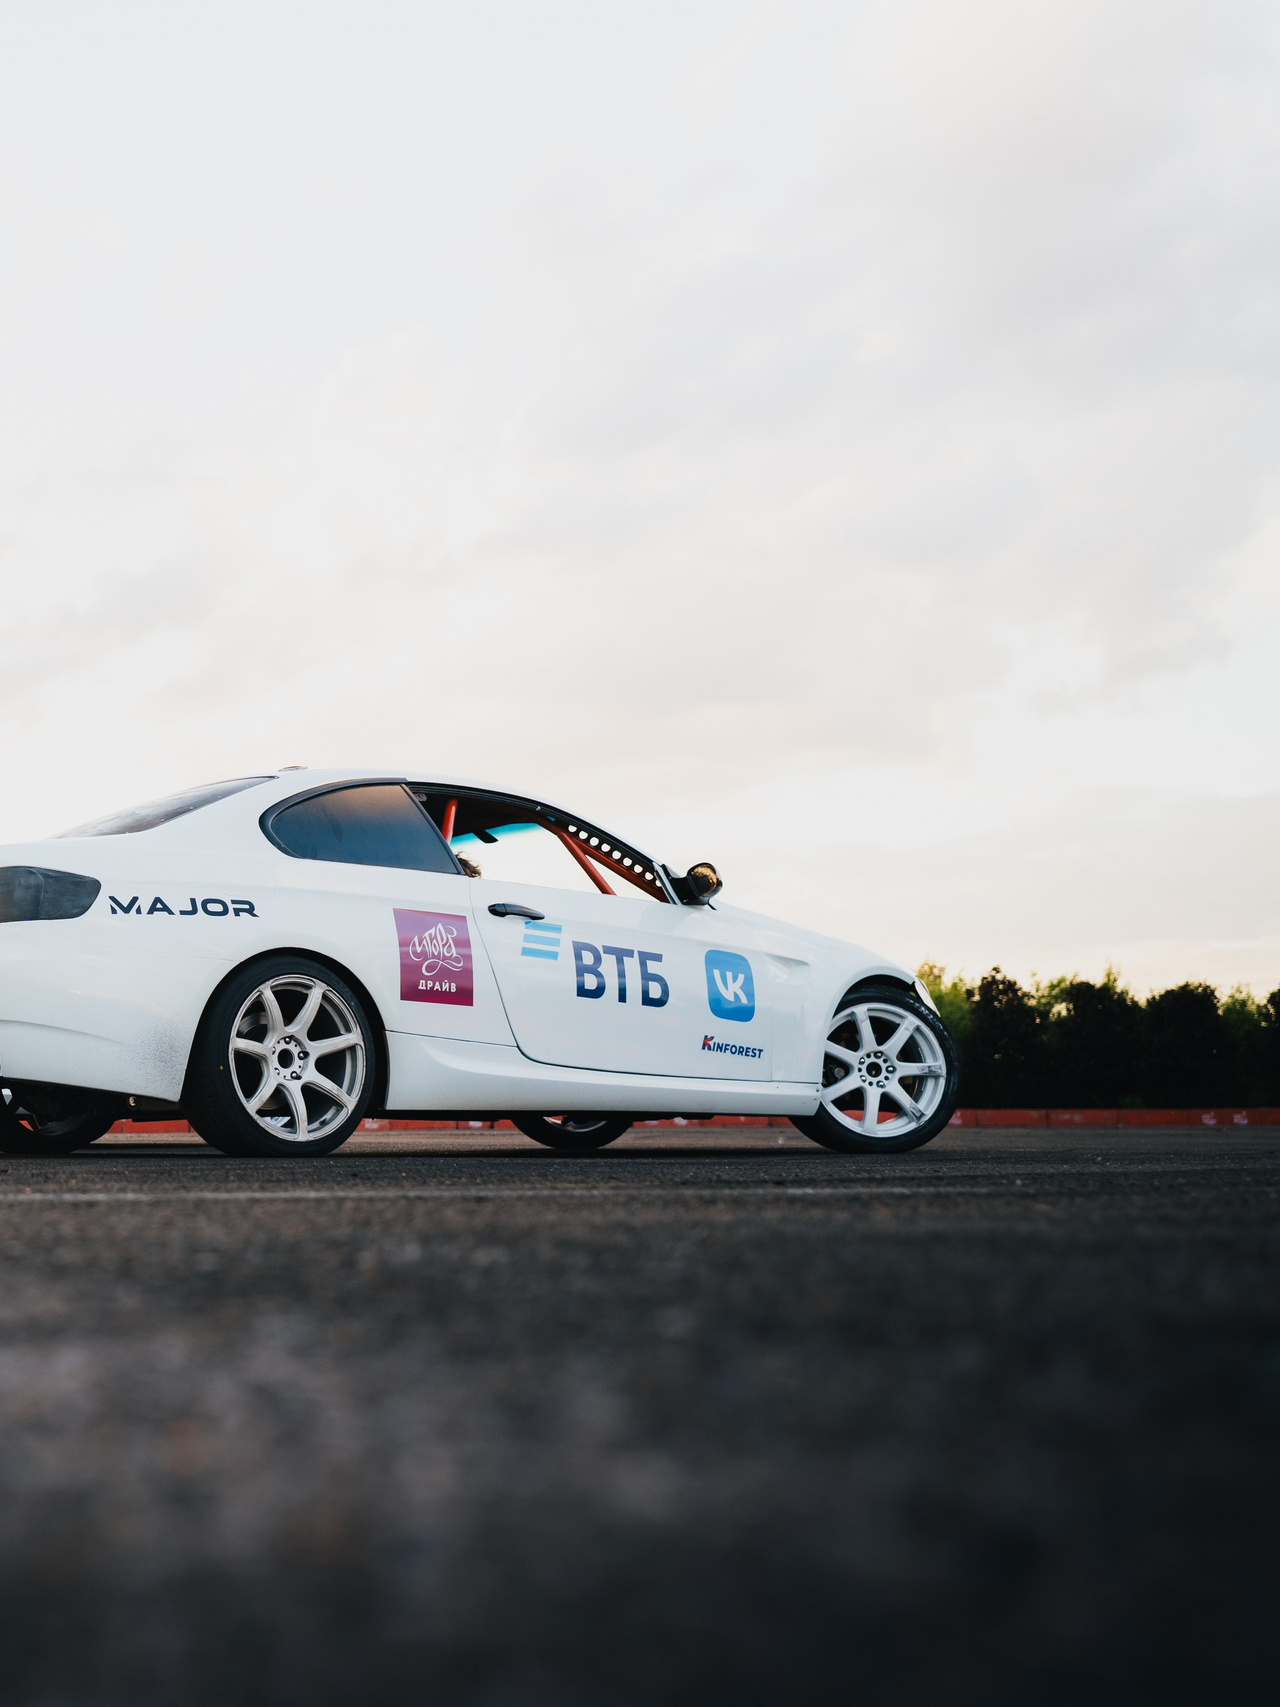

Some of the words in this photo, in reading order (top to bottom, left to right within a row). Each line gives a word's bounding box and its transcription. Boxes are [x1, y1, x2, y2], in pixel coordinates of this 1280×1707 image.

[108, 895, 260, 918] MAJOR
[418, 980, 457, 993] ДРАЙВ
[572, 940, 670, 1008] ВТБ
[713, 969, 748, 1005] VK
[701, 1034, 764, 1059] KINFOREST
